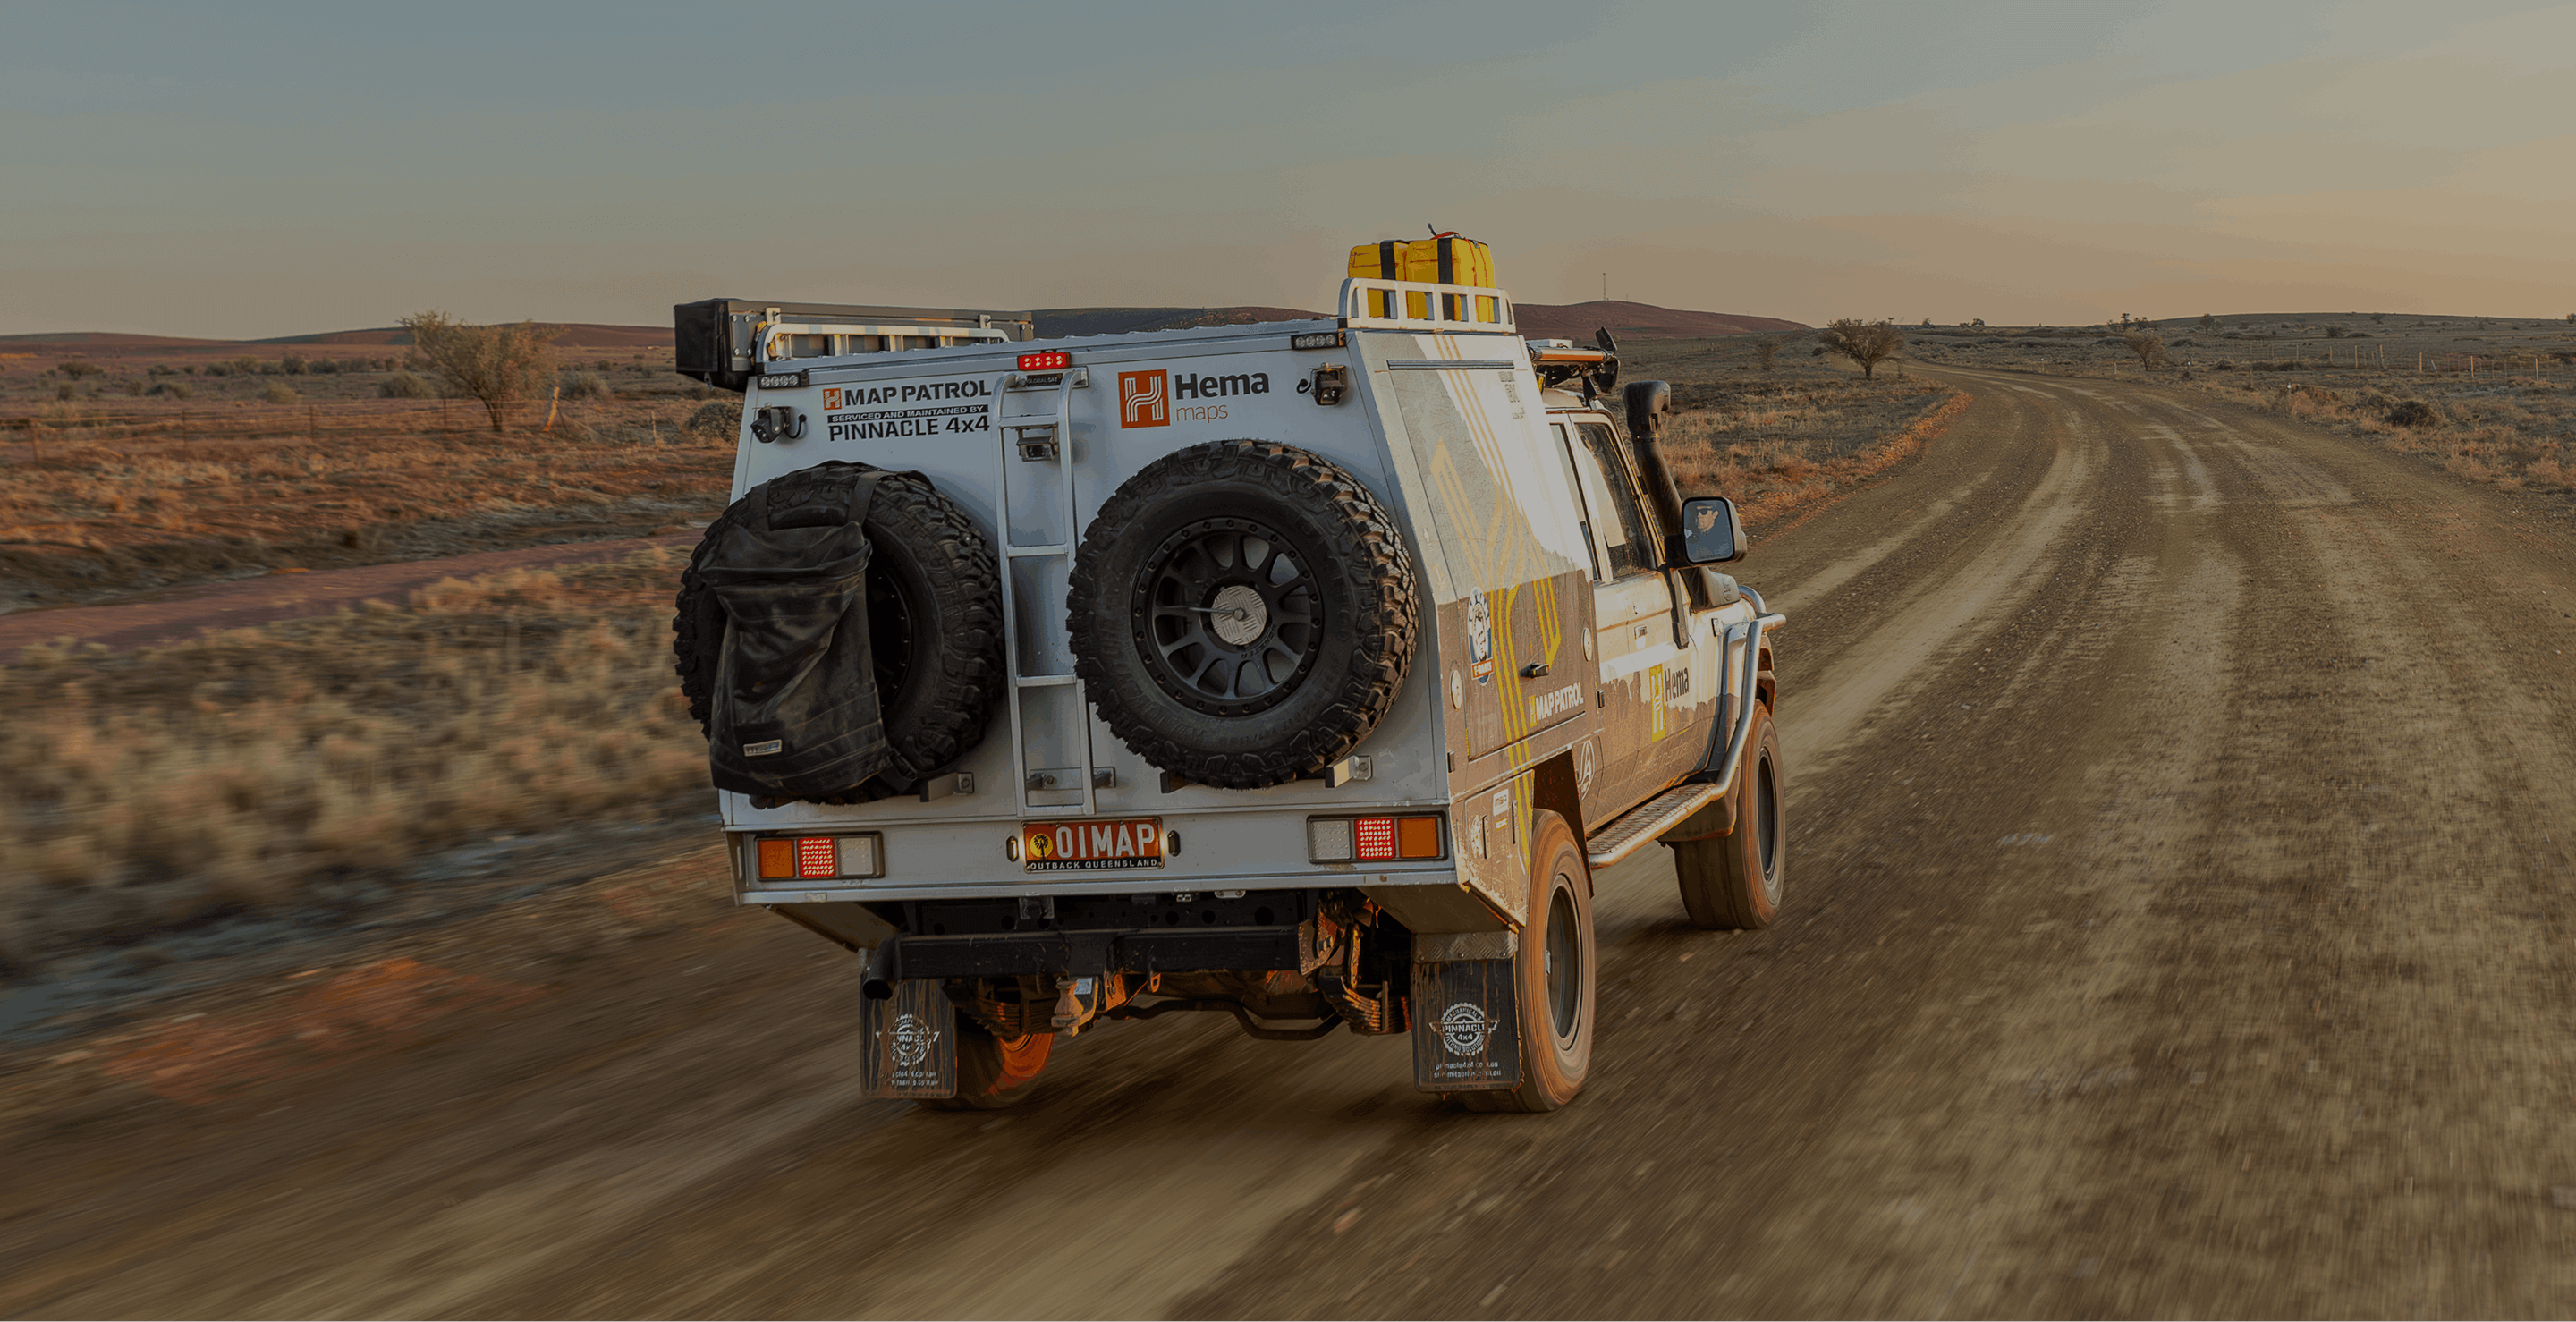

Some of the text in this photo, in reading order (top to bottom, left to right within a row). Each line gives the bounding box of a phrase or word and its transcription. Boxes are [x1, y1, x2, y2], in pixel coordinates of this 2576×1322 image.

[844, 385, 898, 406] MAP
[902, 380, 992, 402] PATROL
[1174, 372, 1270, 400] Hema
[832, 405, 984, 422] SERVICED AND MAINTAINED BY
[1176, 404, 1229, 423] maps
[828, 415, 990, 442] PINNACLE 4x4
[1665, 667, 1690, 702] Hema
[1536, 691, 1555, 721] MAP
[1555, 682, 1584, 714] PATROL
[1030, 859, 1157, 870] OUTBACK QUEENSLAND
